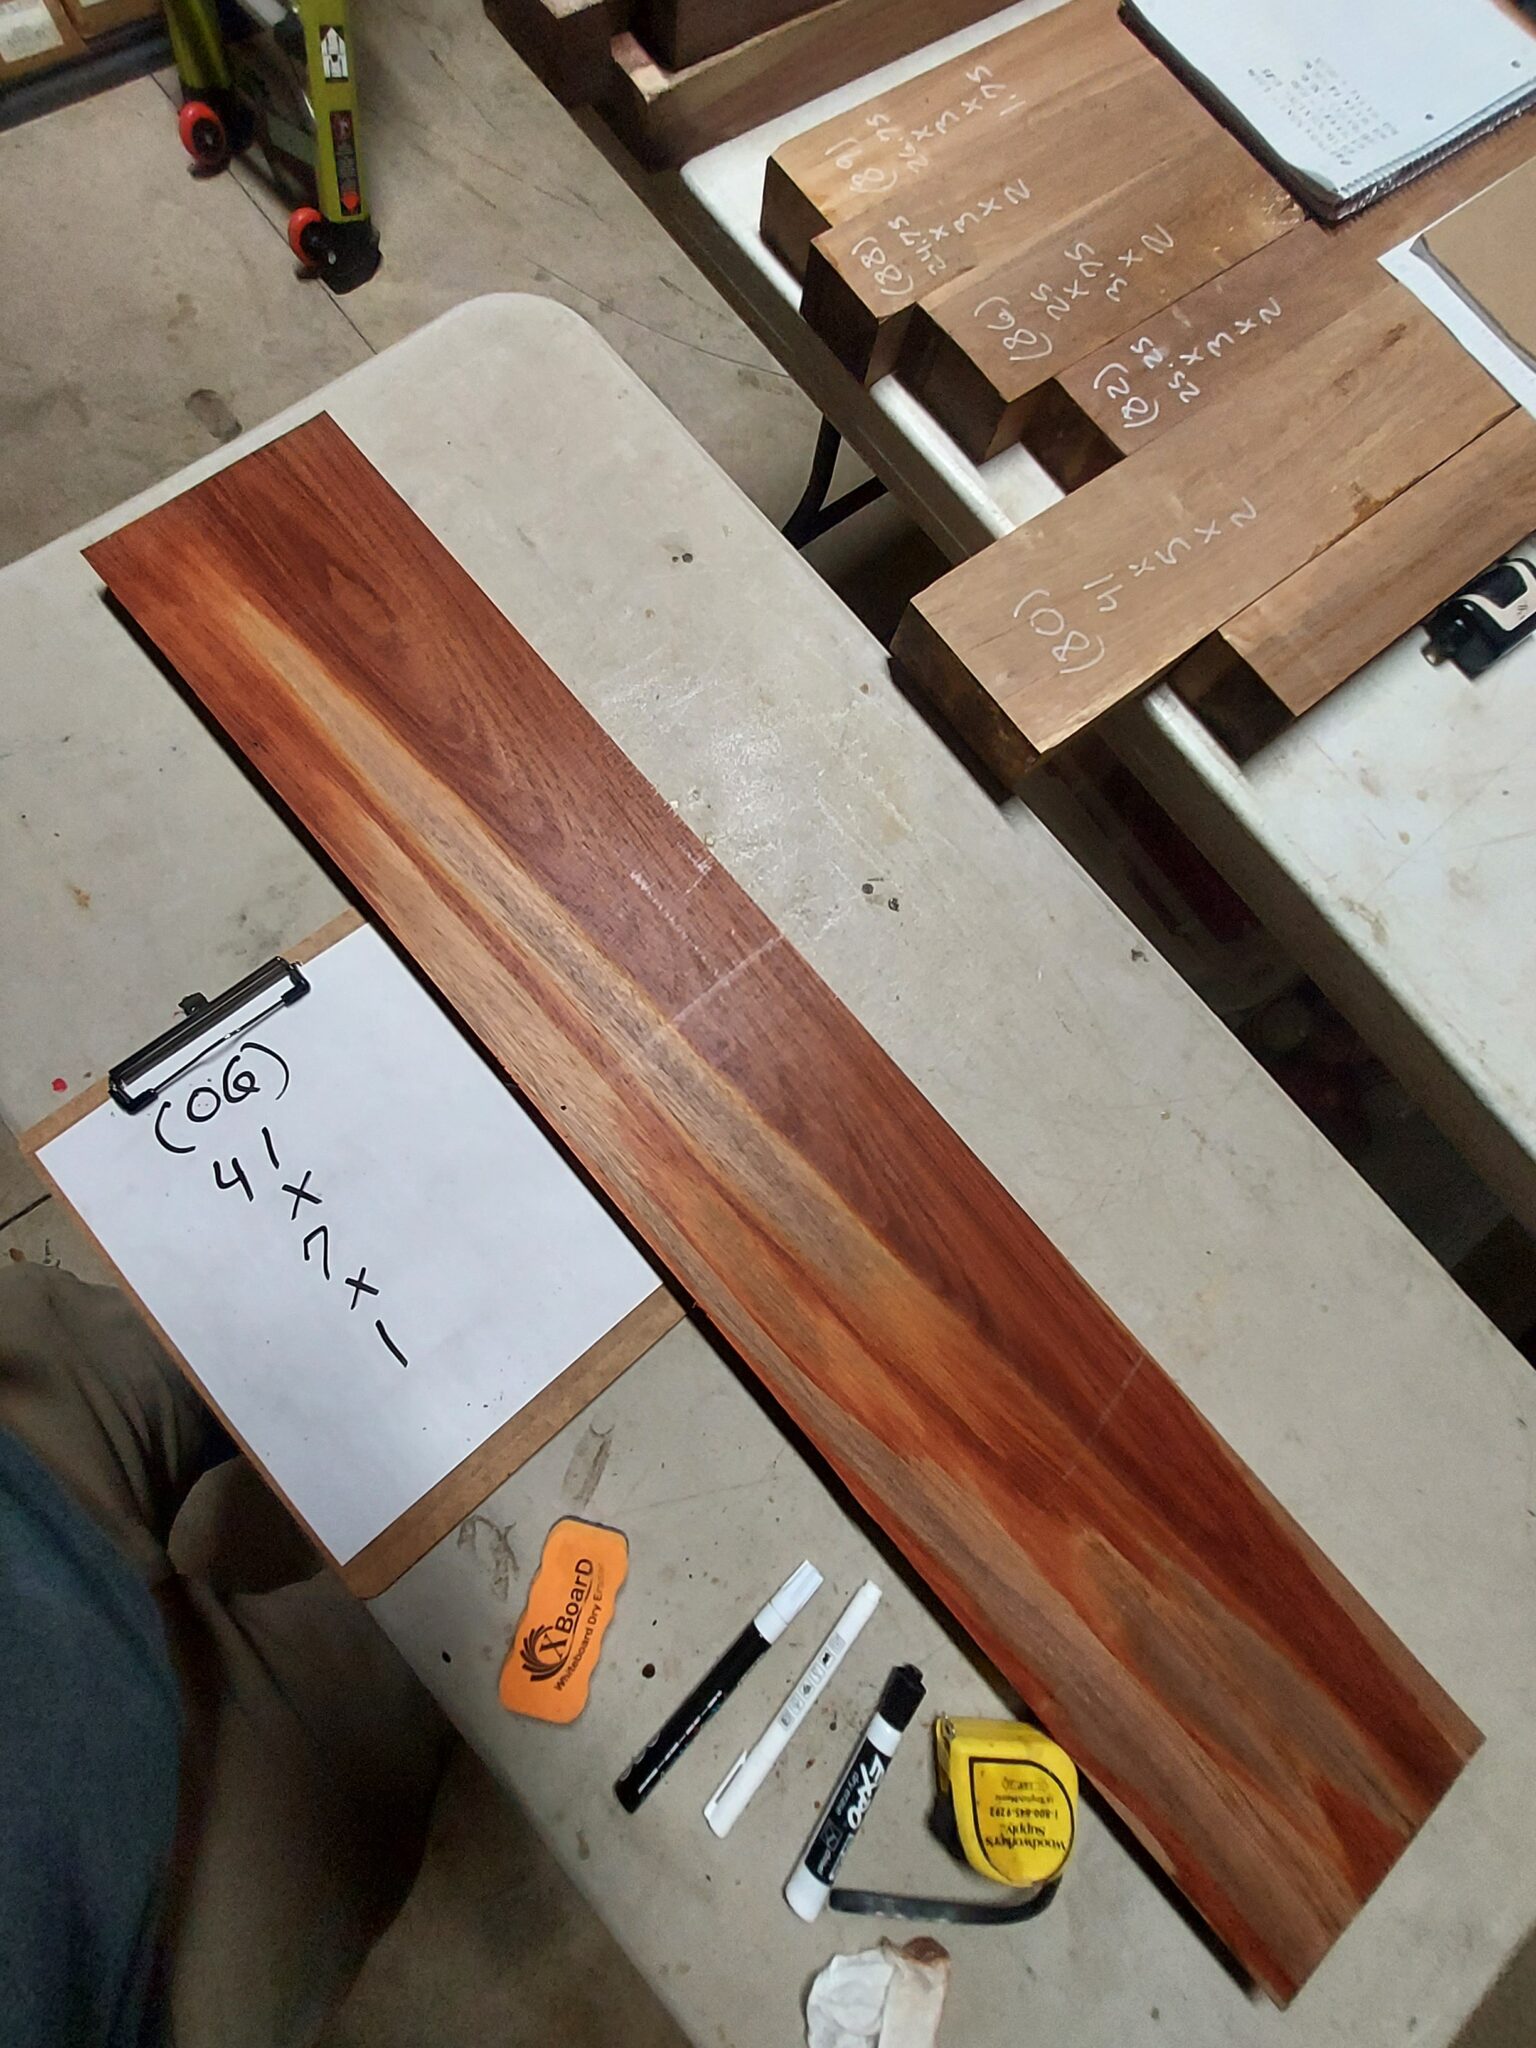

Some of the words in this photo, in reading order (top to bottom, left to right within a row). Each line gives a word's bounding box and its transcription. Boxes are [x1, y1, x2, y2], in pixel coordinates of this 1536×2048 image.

[851, 236, 914, 295] (88)
[974, 296, 1053, 361] (86)
[1093, 362, 1160, 429] (82)
[1013, 589, 1105, 674] (80)
[303, 1225, 331, 1281] 7
[553, 1627, 594, 1692] Whiteboard
[588, 1604, 602, 1626] Dry
[847, 1753, 885, 1830] EXPO
